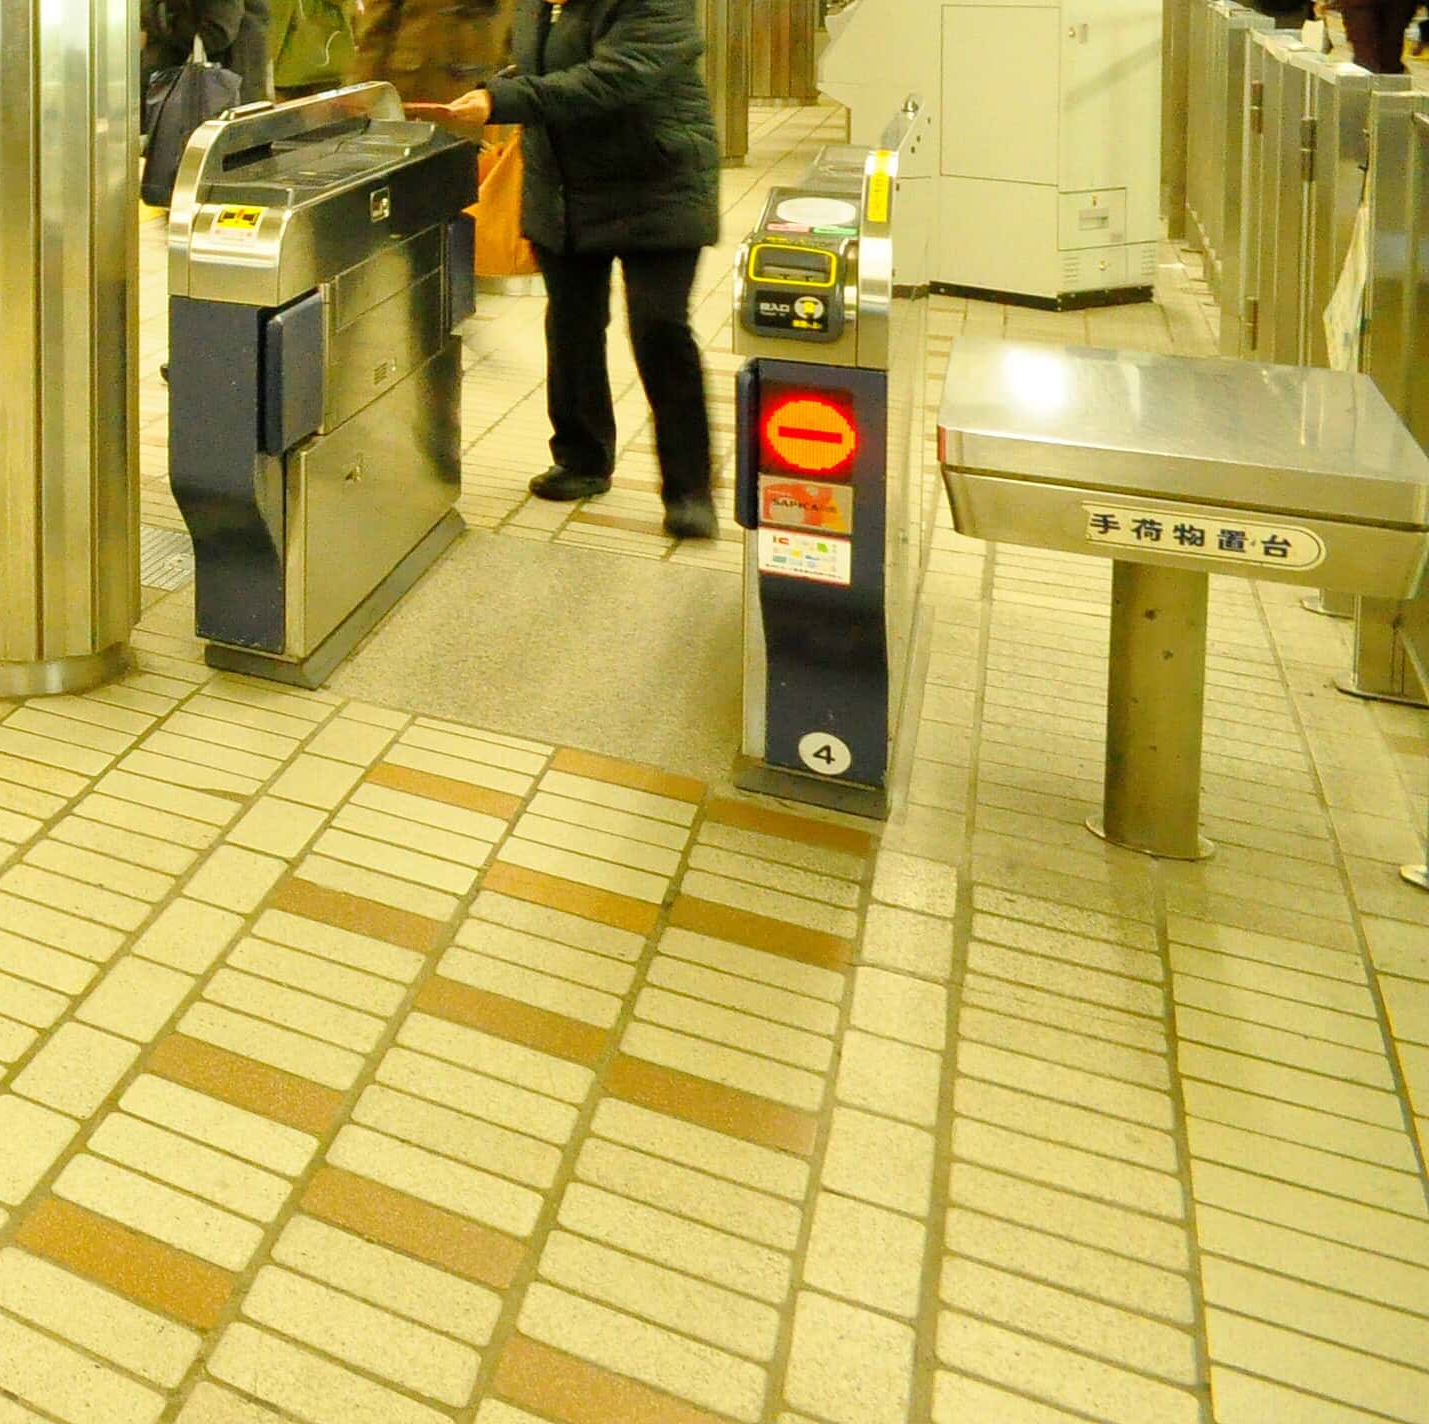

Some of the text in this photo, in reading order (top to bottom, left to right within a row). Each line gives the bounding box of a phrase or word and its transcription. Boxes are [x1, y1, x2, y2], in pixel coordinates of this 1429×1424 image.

[772, 498, 820, 511] SAPICA
[1089, 513, 1292, 558] 手荷物置台
[812, 744, 836, 765] 4
